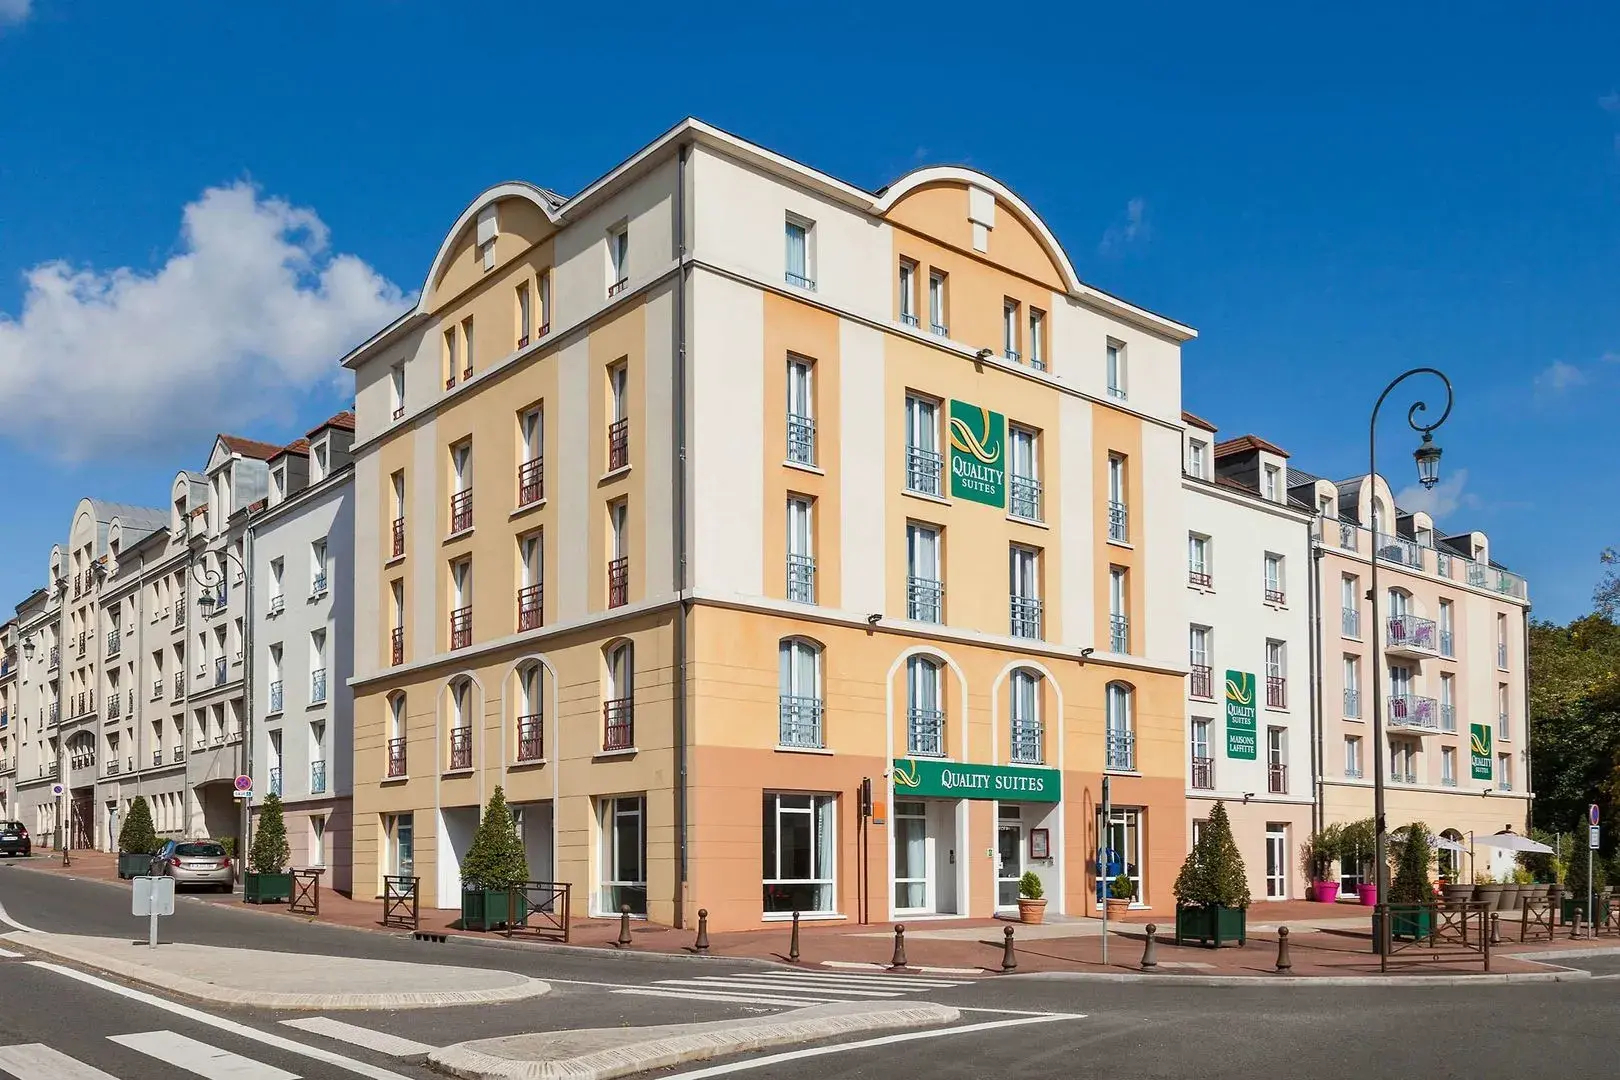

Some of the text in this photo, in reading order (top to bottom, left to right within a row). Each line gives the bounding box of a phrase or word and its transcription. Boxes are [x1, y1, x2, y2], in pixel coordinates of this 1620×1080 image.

[953, 455, 1003, 485] QUALITY
[962, 478, 996, 495] SUITES
[1227, 702, 1255, 717] QUALITY
[1232, 716, 1251, 725] SUITES
[1230, 735, 1254, 744] MAISONS
[1229, 743, 1255, 753] LAFFITTE
[941, 769, 1044, 792] QUALITY SUITES
